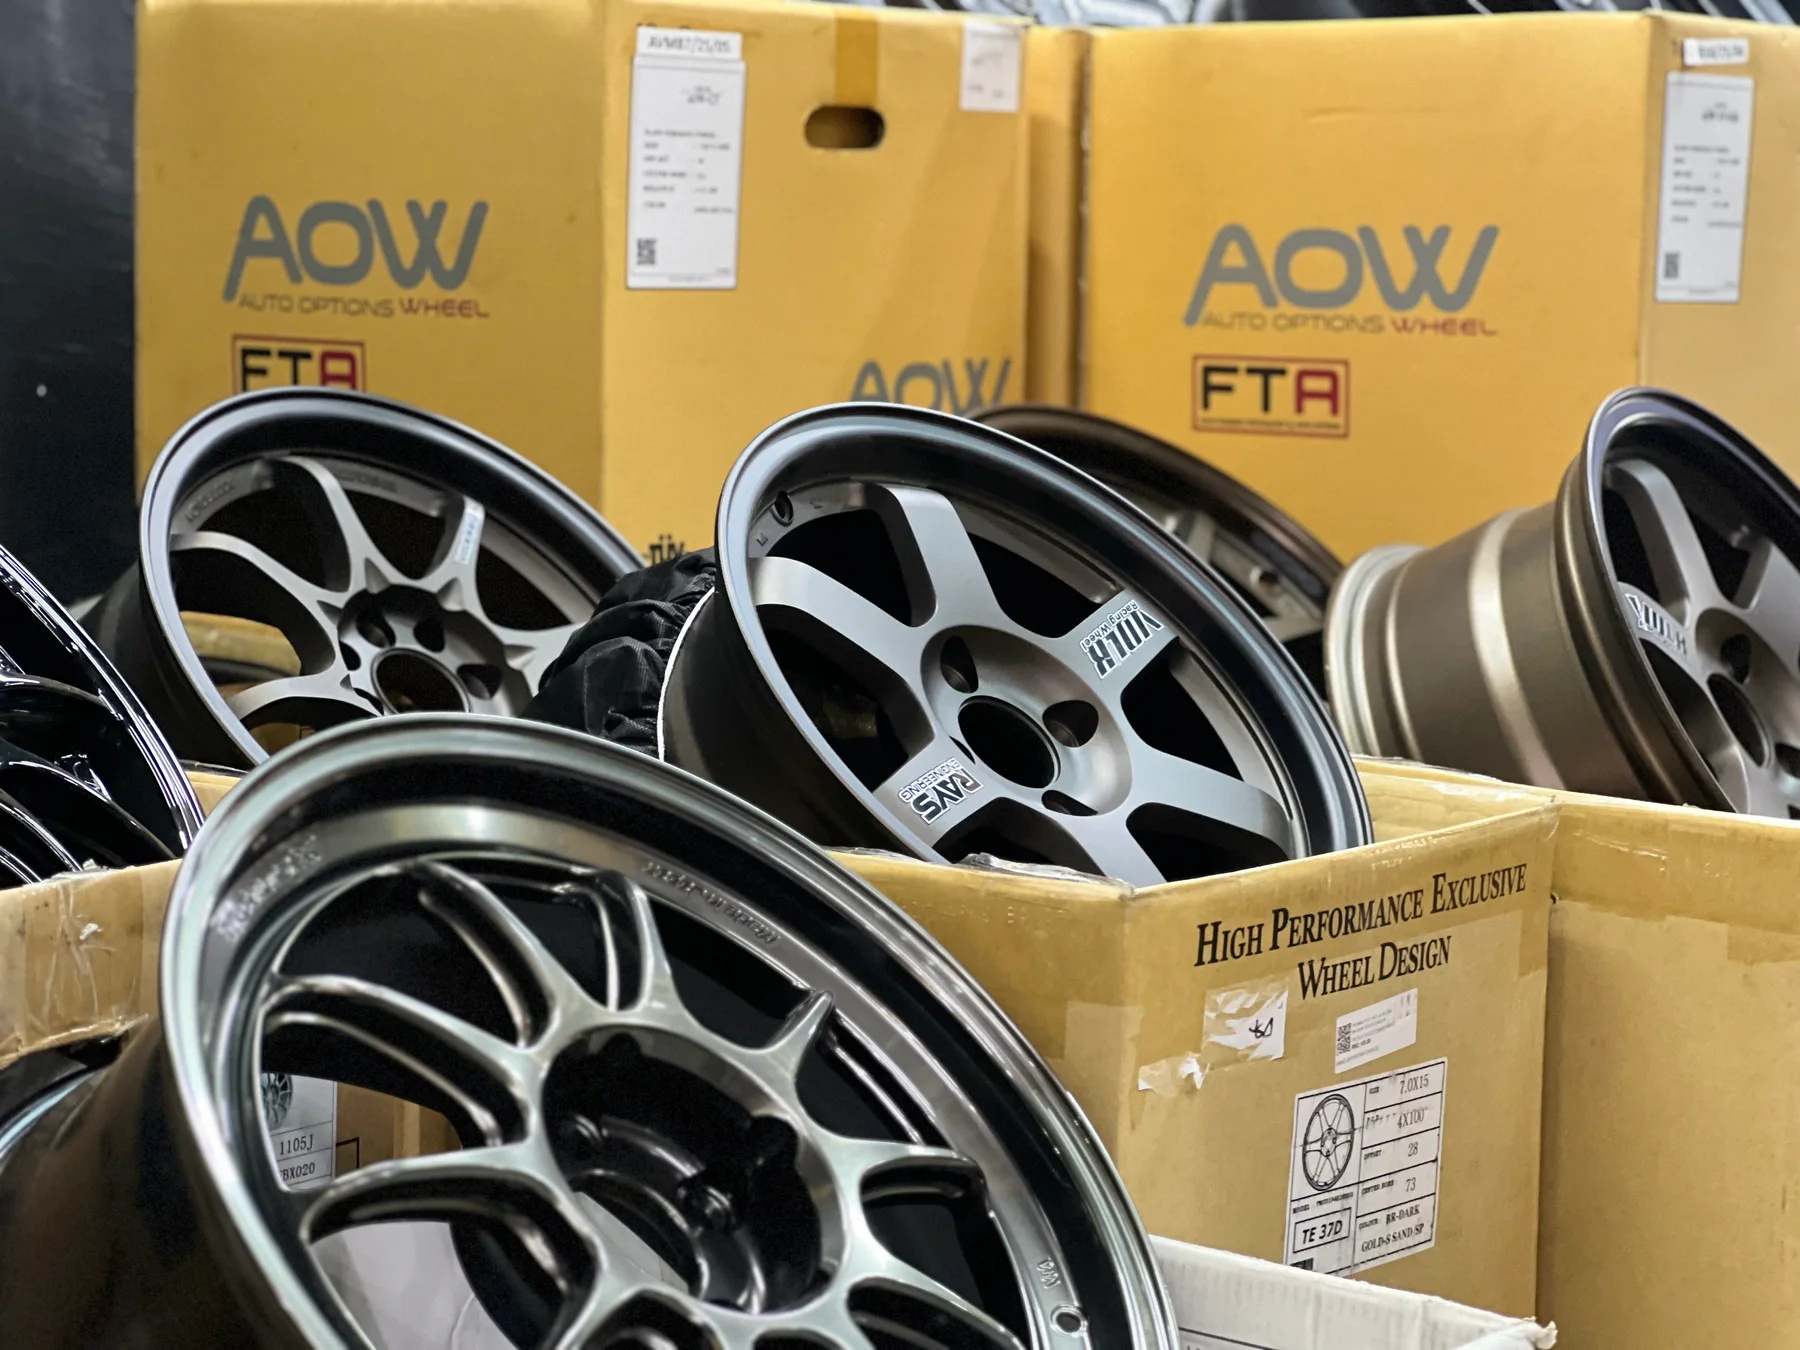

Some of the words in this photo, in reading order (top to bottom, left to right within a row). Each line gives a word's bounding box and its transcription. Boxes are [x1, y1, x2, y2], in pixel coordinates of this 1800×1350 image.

[223, 195, 489, 302] AOW
[1184, 222, 1500, 326] AOW
[238, 293, 295, 313] AUTO
[297, 295, 395, 318] OPTIONS
[399, 297, 490, 319] WHEEL
[1201, 312, 1267, 332] AUTO
[1272, 312, 1386, 334] OPTIONS
[1391, 317, 1498, 337] WHEEL
[241, 348, 357, 392] FTA
[1201, 365, 1339, 416] FTA
[1107, 600, 1139, 626] Racing
[1080, 622, 1112, 652] Wheel
[1086, 608, 1165, 679] VOLK
[899, 757, 962, 802] ENGINEERING
[911, 767, 983, 823] RAYS
[1194, 921, 1264, 967] HIGH
[1269, 889, 1423, 950] PERFORMANCE
[1430, 863, 1527, 914] EXCLUSIVE
[1298, 955, 1375, 1000] WHEEL
[1378, 936, 1452, 981] DESIGN
[1400, 1074, 1429, 1095] 7.0X15
[1397, 1108, 1425, 1129] 4X100
[280, 1134, 314, 1155] 1105J
[1407, 1142, 1419, 1157] 28
[1405, 1177, 1416, 1192] 73
[1385, 1204, 1421, 1225] BR-DARK
[1302, 1226, 1316, 1245] TE
[1319, 1219, 1343, 1240] 37D
